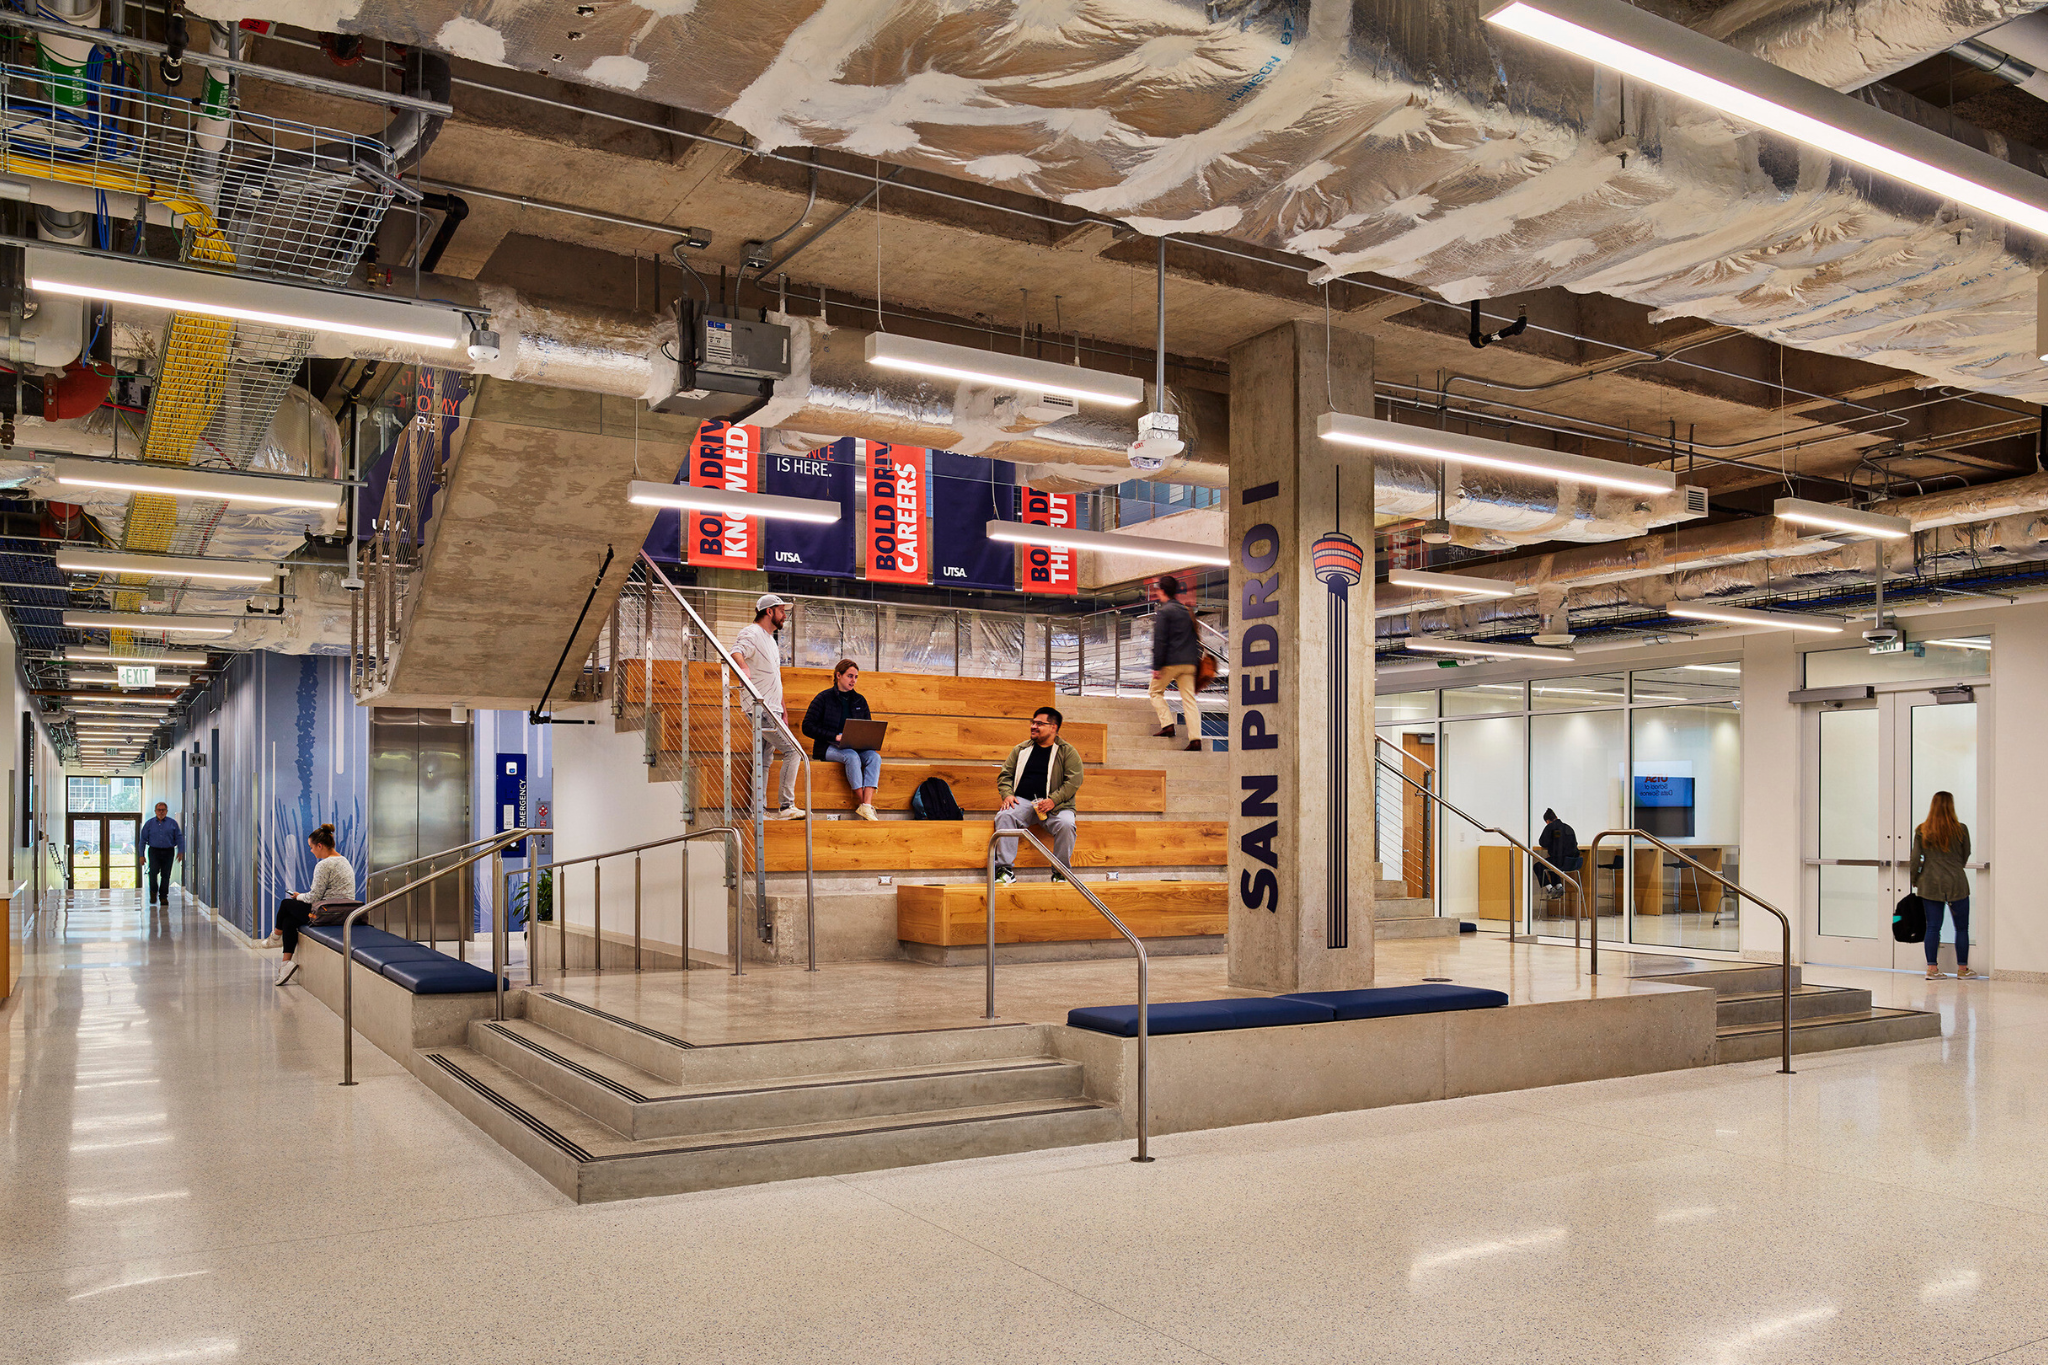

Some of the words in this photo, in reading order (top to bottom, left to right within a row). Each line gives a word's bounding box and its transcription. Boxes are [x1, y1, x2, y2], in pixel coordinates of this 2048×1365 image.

[724, 423, 749, 558] KNOWLED
[777, 457, 791, 472] IS
[794, 459, 832, 478] HERE.
[1241, 481, 1280, 505] I
[700, 485, 723, 556] BO
[875, 504, 896, 571] BOLD
[894, 462, 919, 573] CAREERS
[1049, 492, 1068, 528] UT
[1030, 520, 1050, 582] BO
[1241, 523, 1280, 750] PEDRO
[126, 669, 148, 684] EXIT
[1241, 774, 1279, 914] SAN
